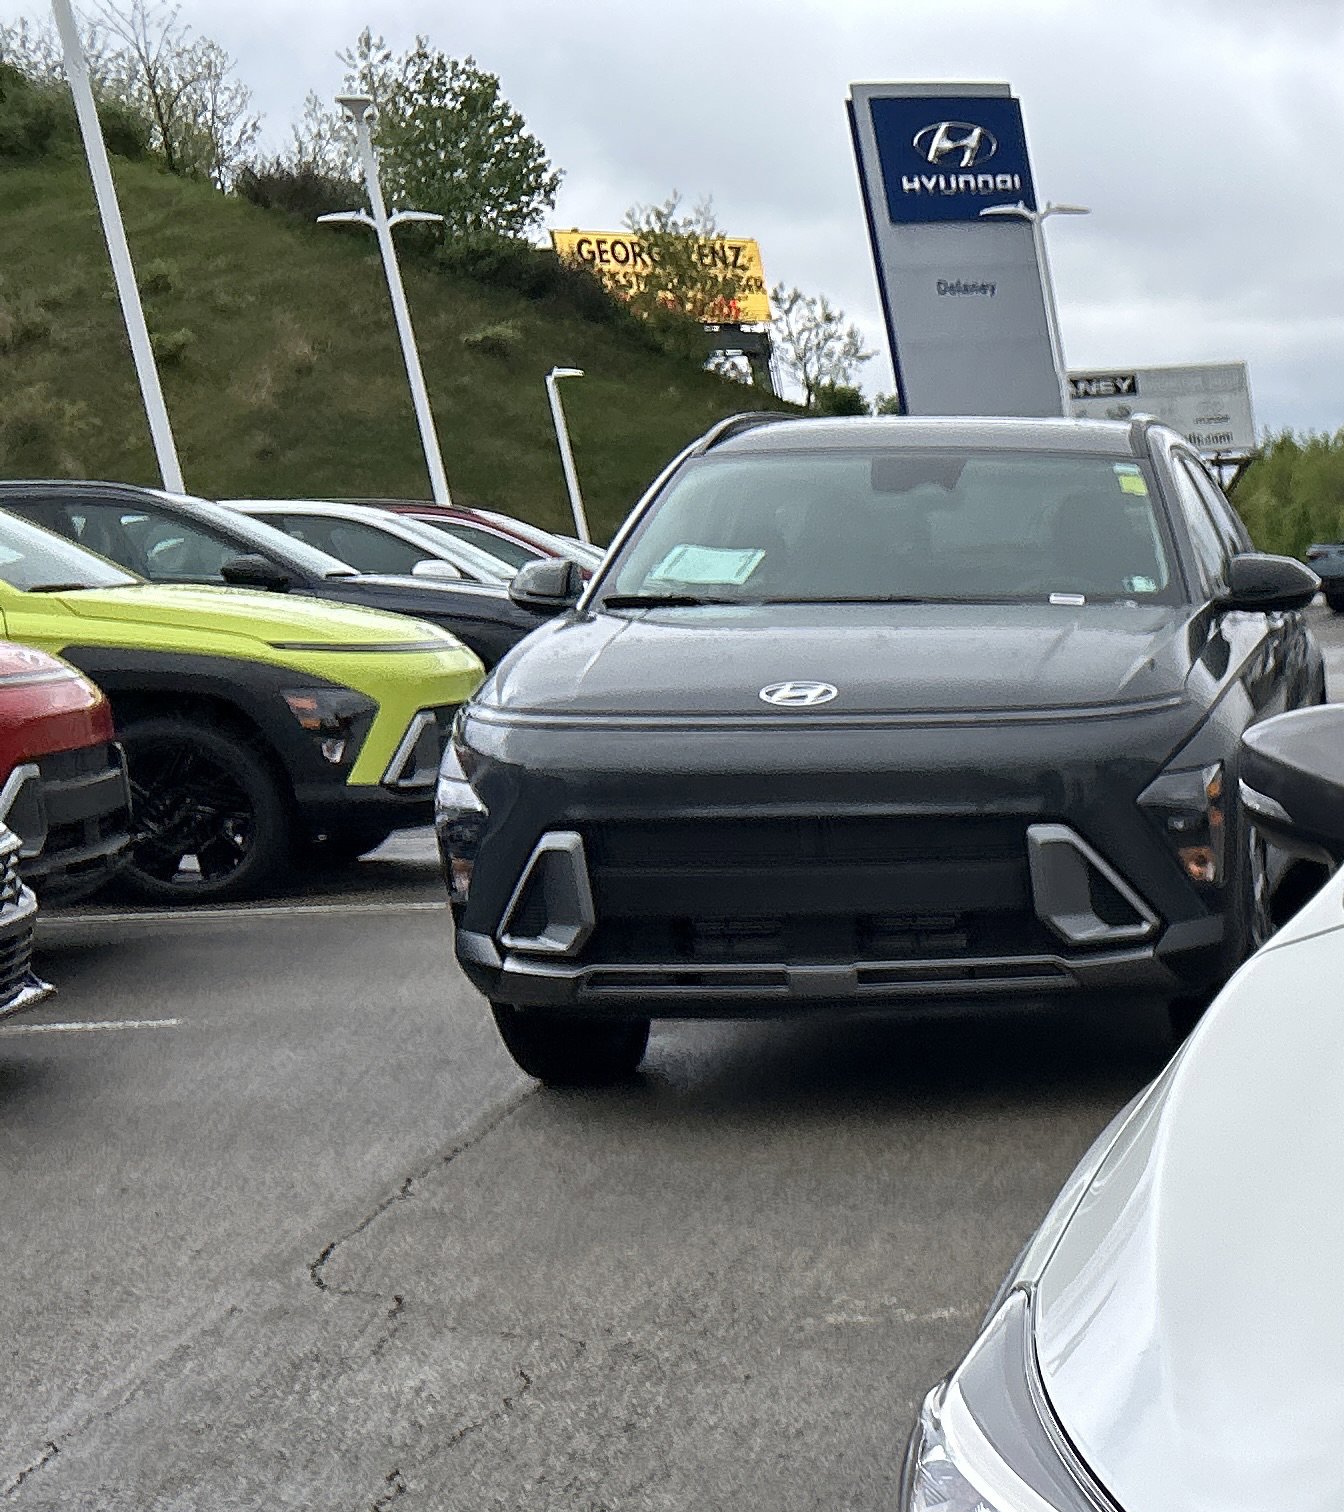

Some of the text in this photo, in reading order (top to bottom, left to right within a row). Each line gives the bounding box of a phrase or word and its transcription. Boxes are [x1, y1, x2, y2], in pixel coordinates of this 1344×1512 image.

[901, 173, 1021, 196] HYUNDAI
[692, 243, 749, 271] ENZ
[936, 276, 998, 297] Delaney
